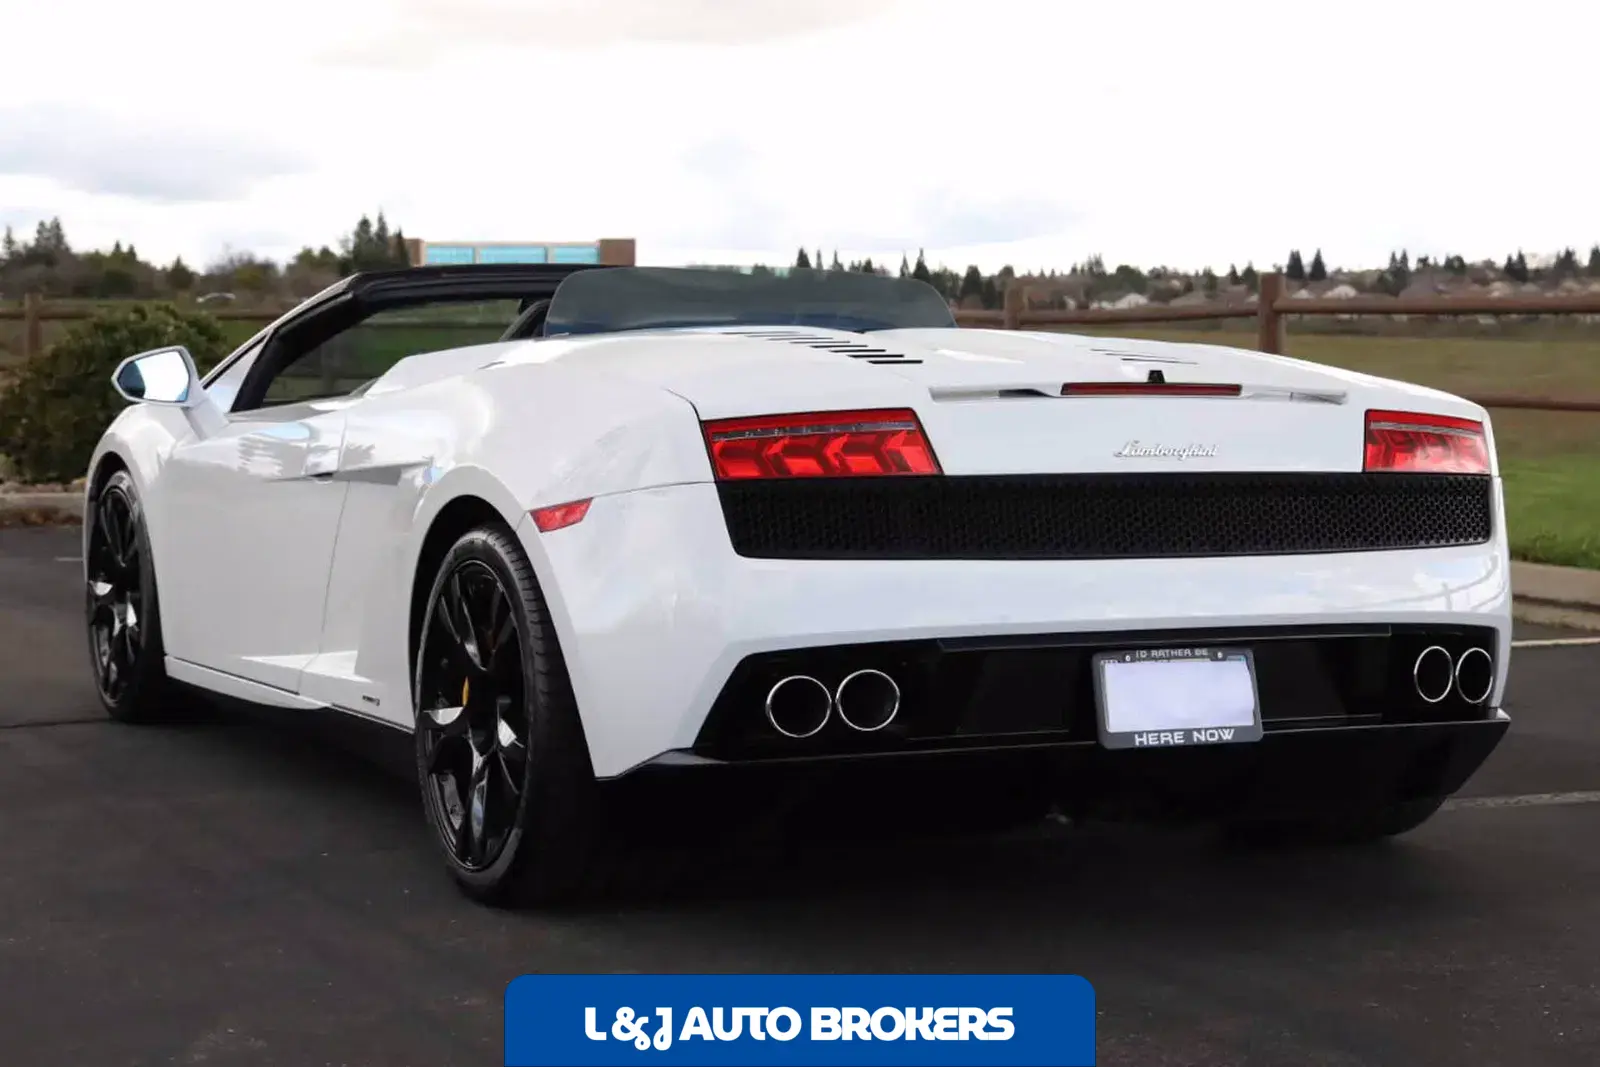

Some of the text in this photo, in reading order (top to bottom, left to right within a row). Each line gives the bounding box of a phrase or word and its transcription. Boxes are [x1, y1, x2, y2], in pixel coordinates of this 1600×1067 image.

[1112, 439, 1219, 462] Lamborghini
[1151, 649, 1192, 658] RATHER
[1134, 728, 1235, 746] HERE NOW
